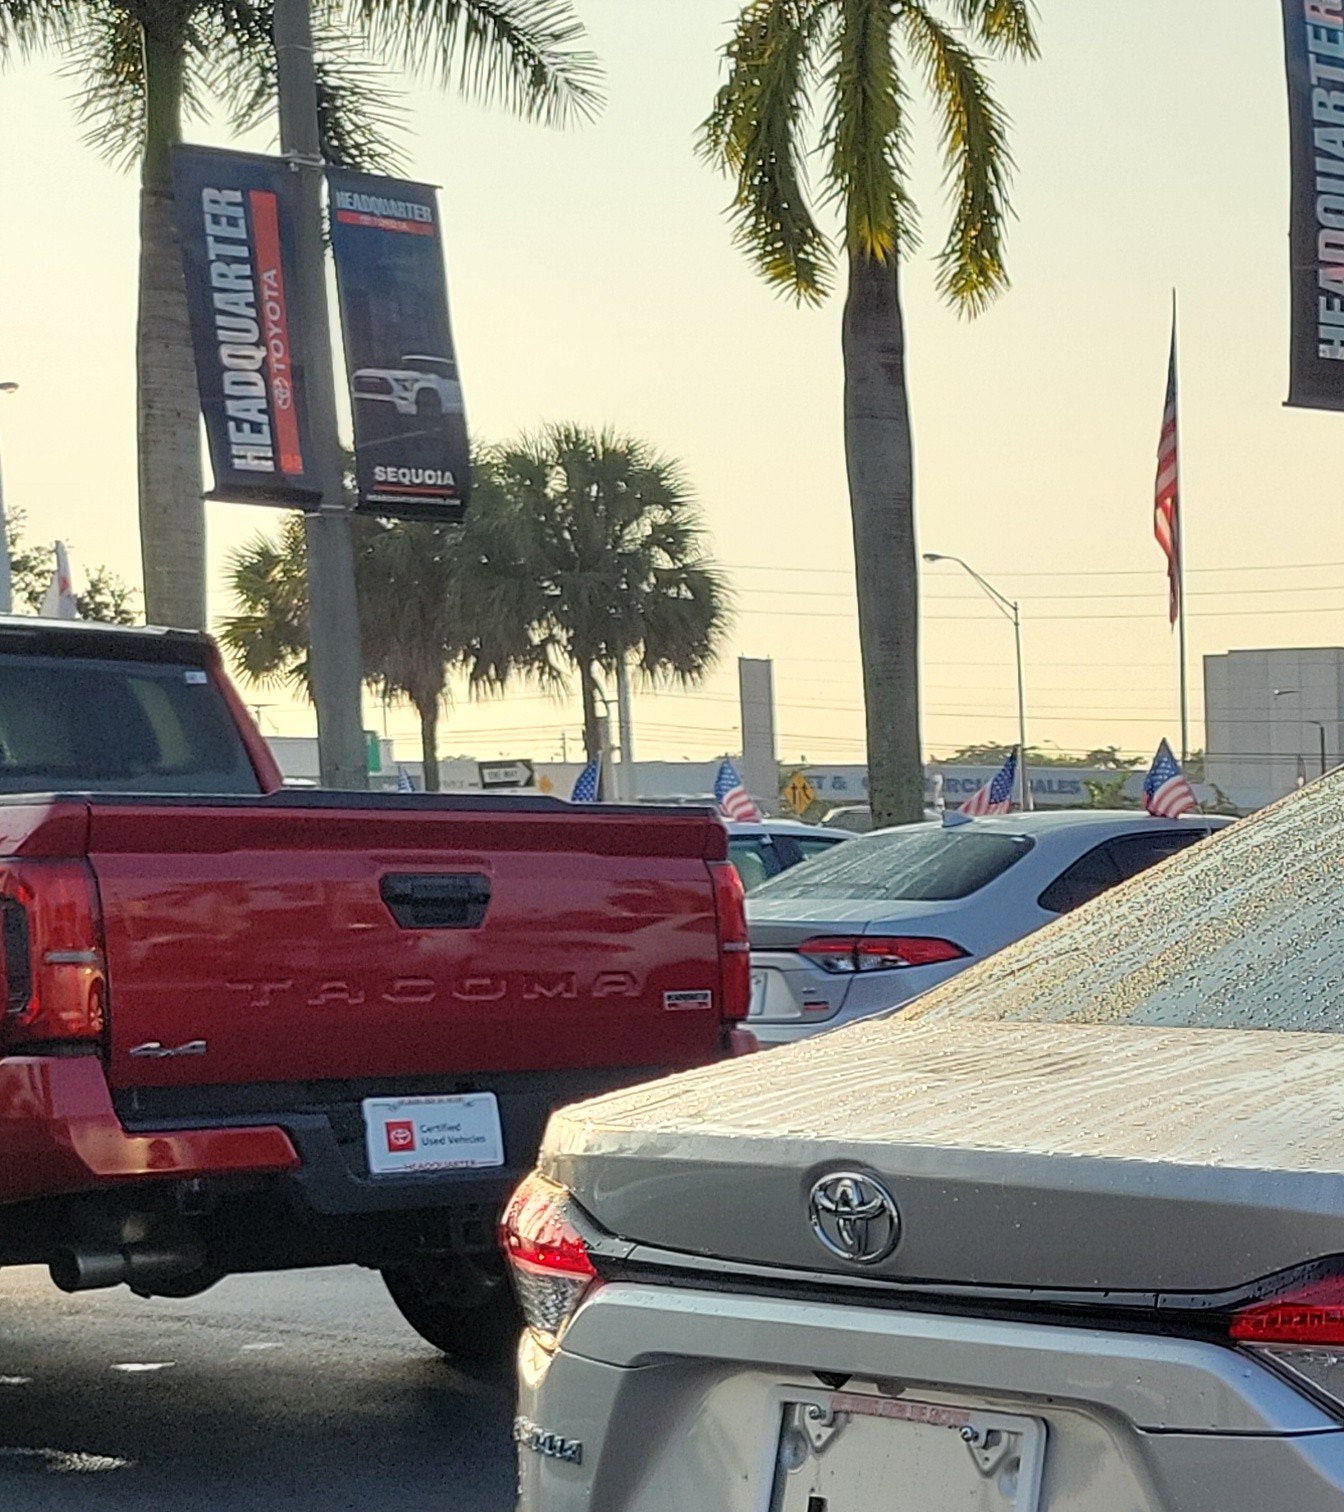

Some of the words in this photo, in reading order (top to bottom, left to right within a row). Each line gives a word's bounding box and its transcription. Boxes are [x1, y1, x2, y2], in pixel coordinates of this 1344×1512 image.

[336, 190, 432, 223] HEADQUARTER
[202, 186, 275, 473] HEADQUARTER
[260, 268, 288, 378] TOYOTA
[373, 465, 455, 486] SEQUOIA
[1031, 779, 1082, 795] ALES
[225, 970, 645, 1007] TACOMA
[420, 1122, 461, 1134] Certified
[421, 1136, 446, 1147] Used
[448, 1134, 486, 1146] Vehicles
